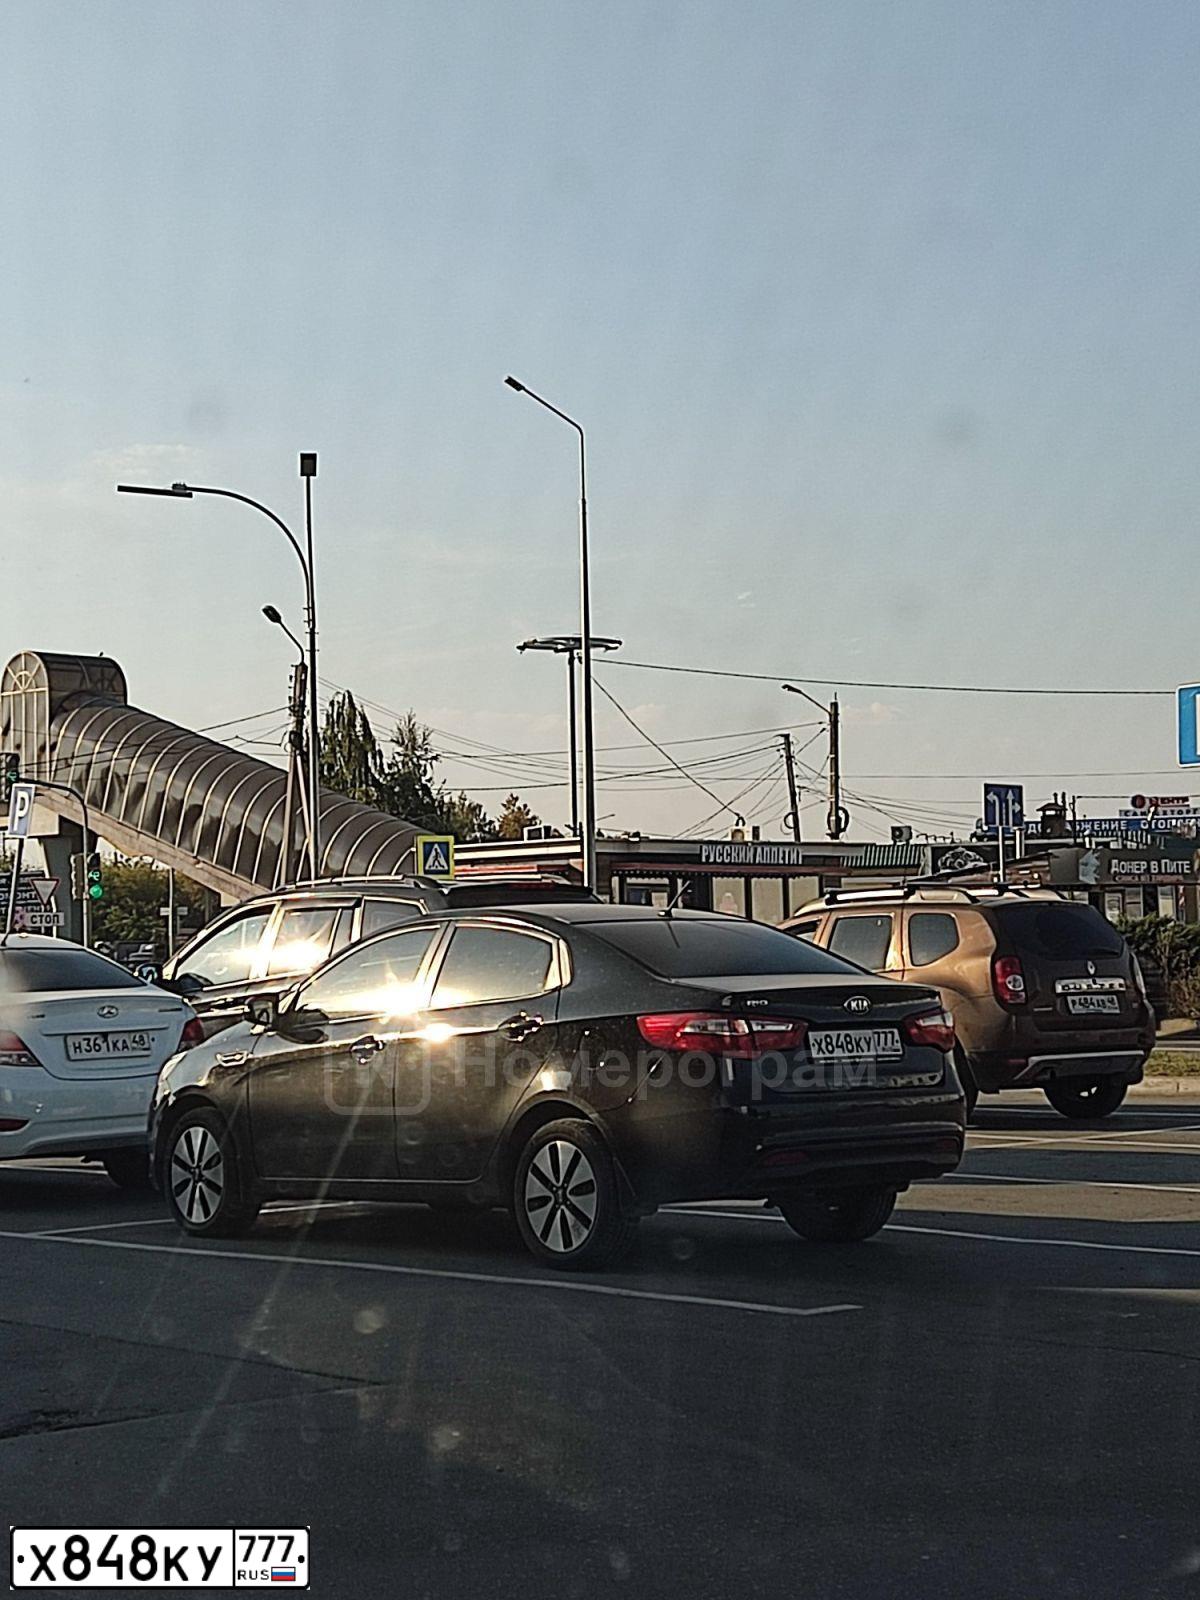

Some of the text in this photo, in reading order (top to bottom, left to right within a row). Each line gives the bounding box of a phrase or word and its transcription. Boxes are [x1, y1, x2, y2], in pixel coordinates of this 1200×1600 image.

[701, 842, 754, 863] РУССКИЙ
[30, 914, 60, 925] СТОП
[850, 1000, 869, 1011] KIA
[72, 1036, 130, 1054] Н361КА
[815, 1030, 895, 1055] Х848КУ 777
